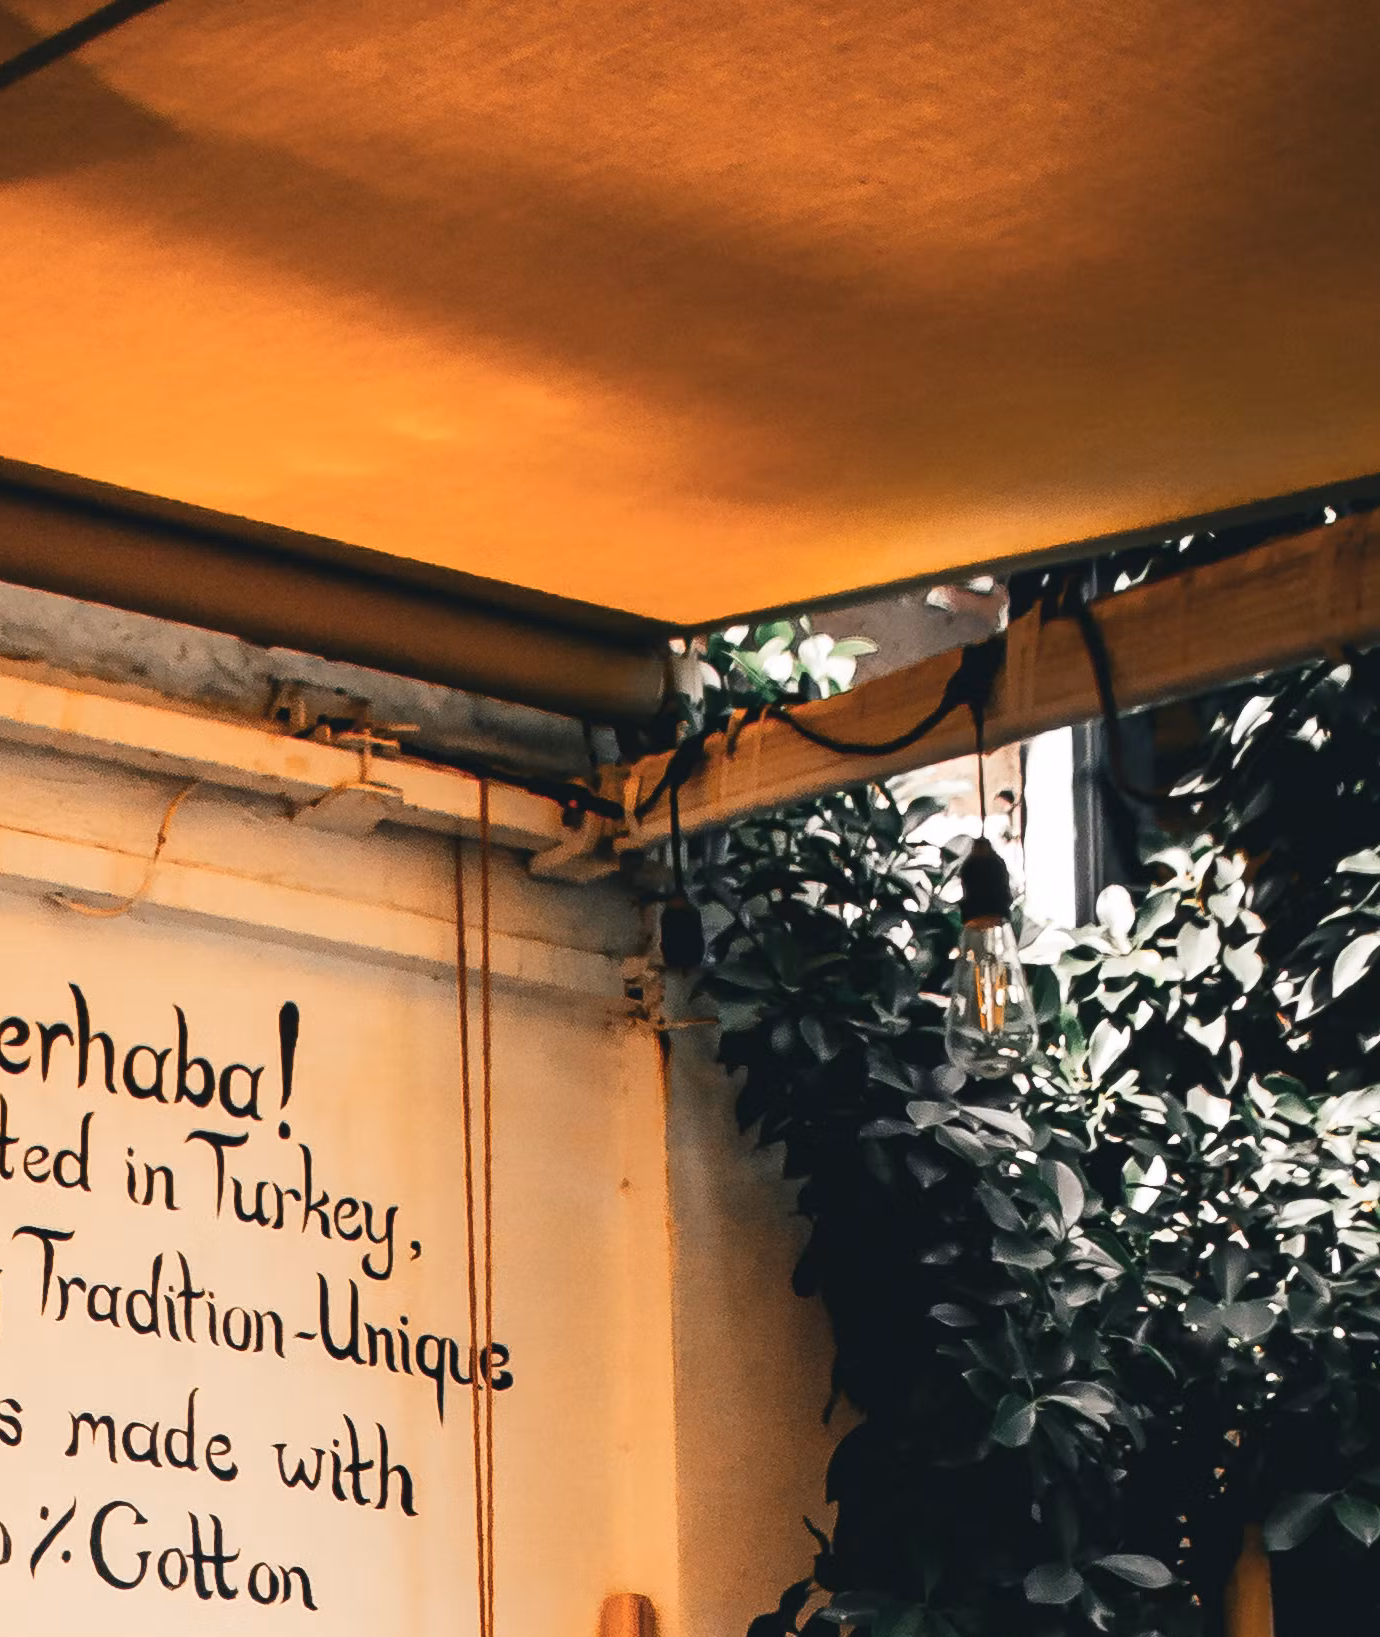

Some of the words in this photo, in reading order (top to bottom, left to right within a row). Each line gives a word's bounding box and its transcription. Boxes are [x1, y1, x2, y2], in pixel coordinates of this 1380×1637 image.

[126, 1147, 178, 1211] in
[185, 1130, 422, 1281] Turkey,
[64, 1387, 239, 1482] made
[272, 1413, 419, 1517] with
[89, 1500, 319, 1612] Cotton
